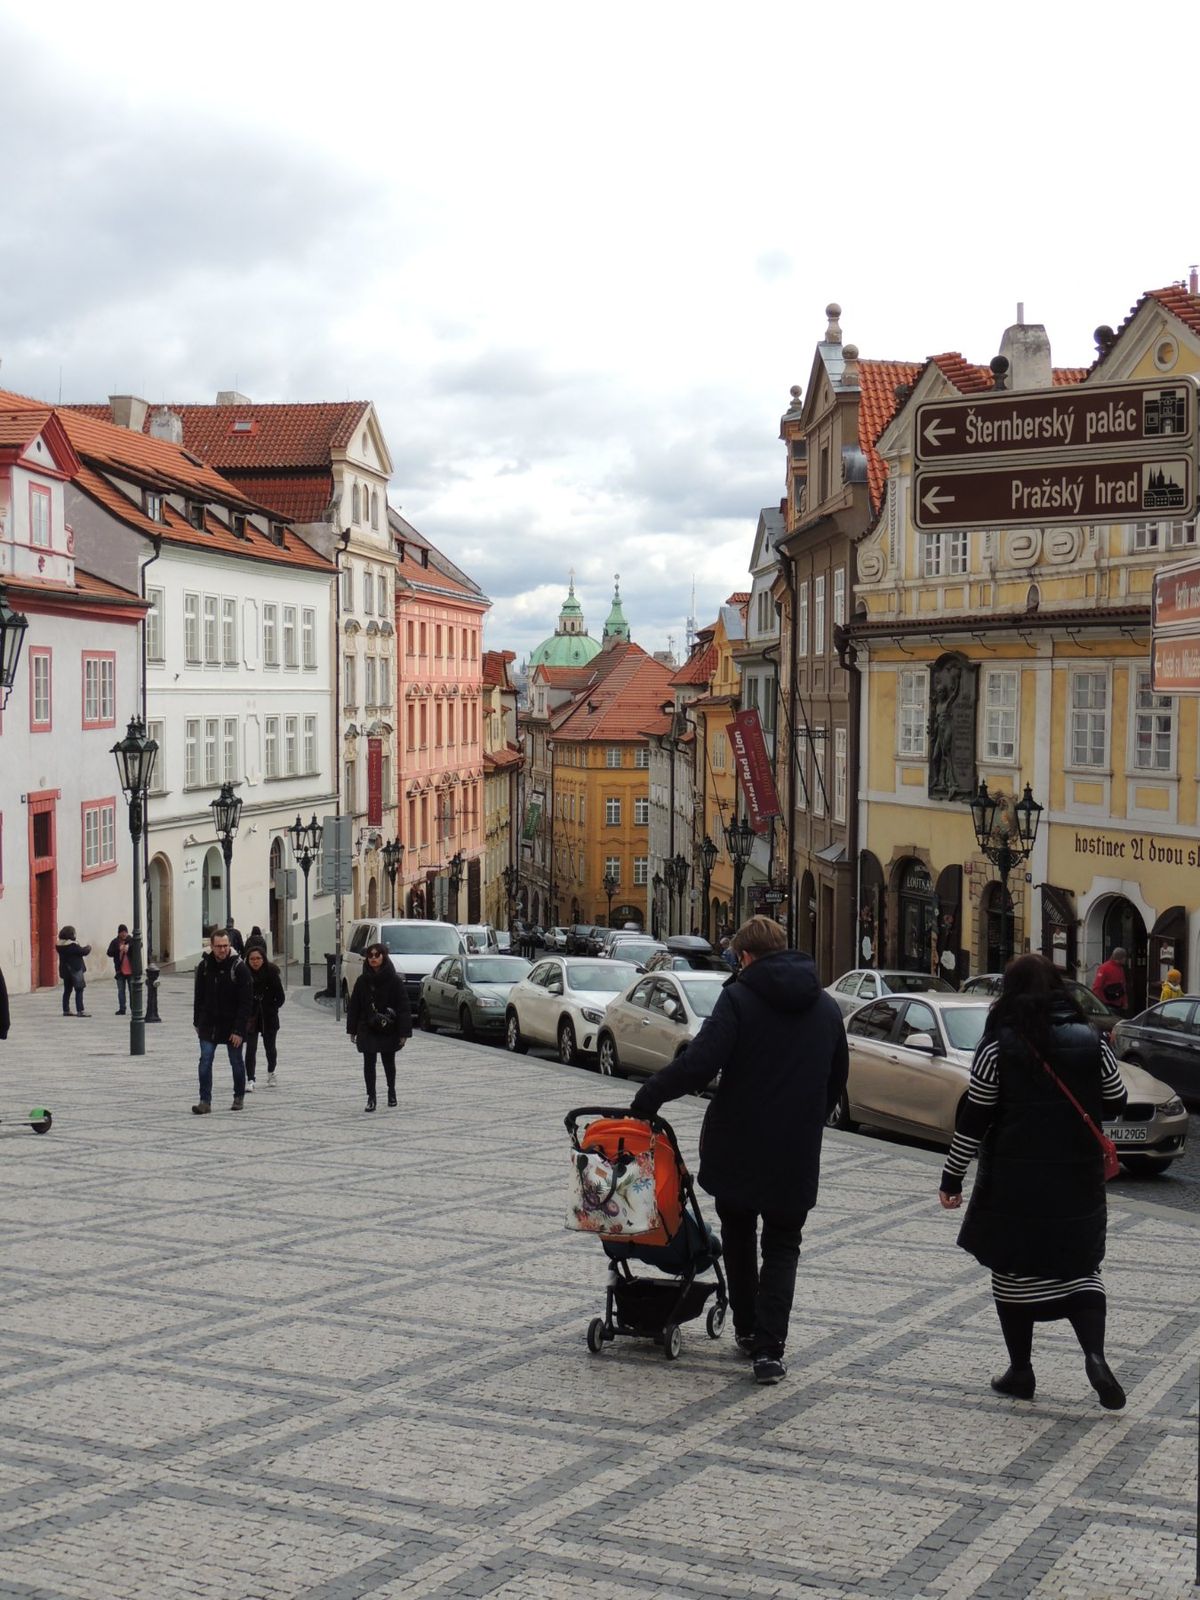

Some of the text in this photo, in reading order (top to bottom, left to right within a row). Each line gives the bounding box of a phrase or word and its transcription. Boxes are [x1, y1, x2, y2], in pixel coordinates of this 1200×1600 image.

[965, 402, 1137, 445] Šternberský palác
[1011, 472, 1138, 514] Pražský hrad
[735, 731, 745, 754] Lion
[740, 758, 751, 780] Red
[1074, 832, 1126, 858] hostinec
